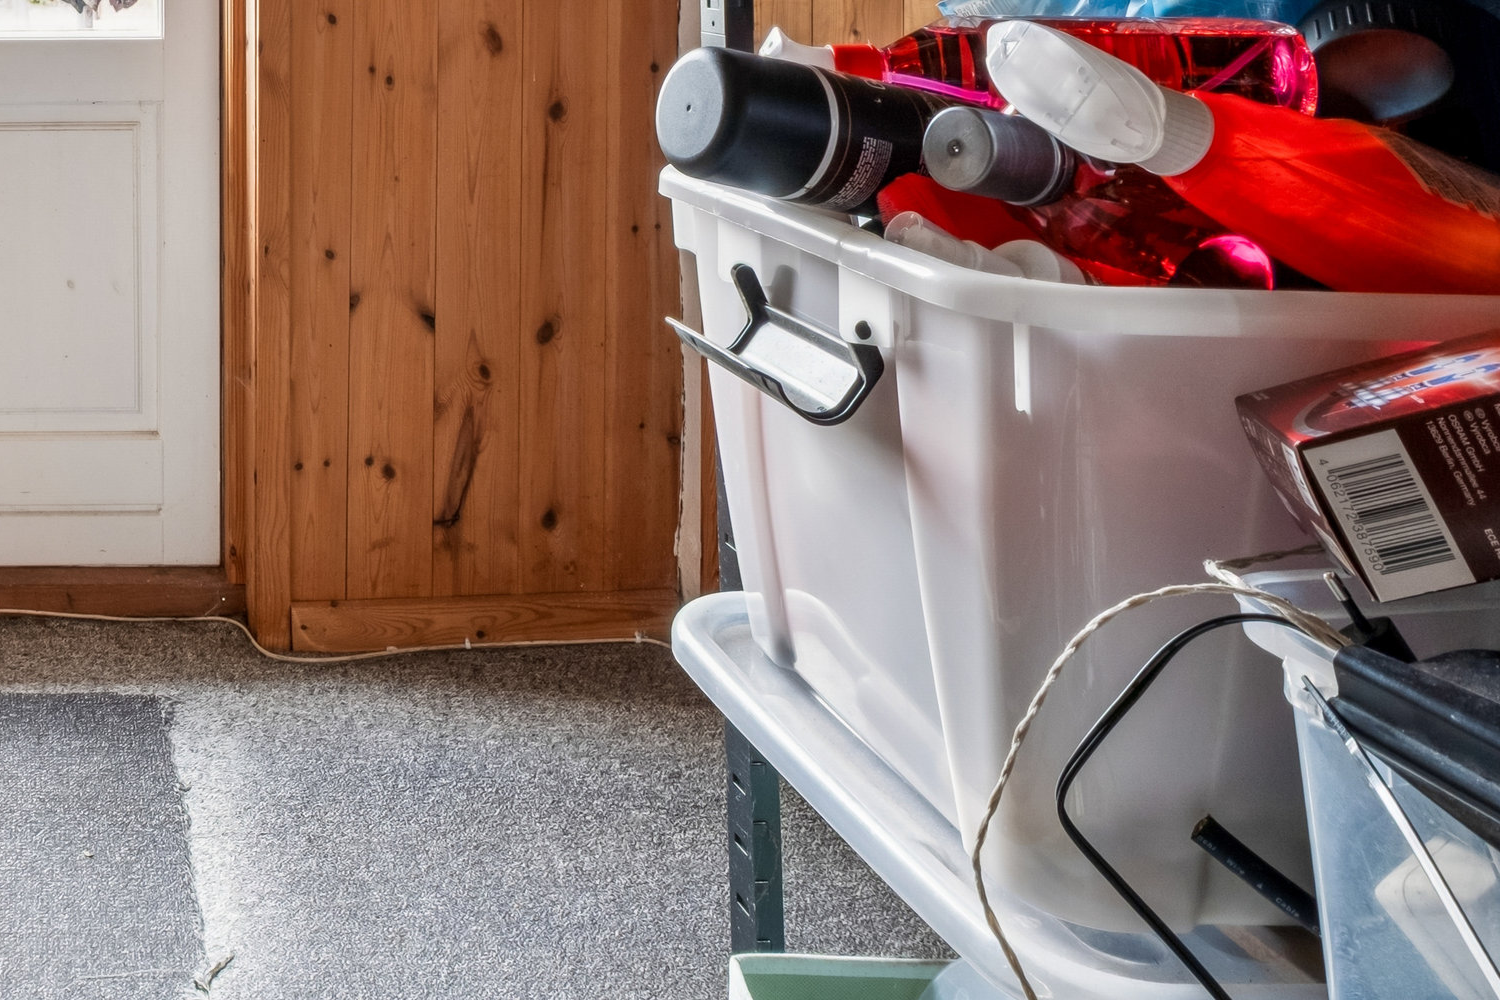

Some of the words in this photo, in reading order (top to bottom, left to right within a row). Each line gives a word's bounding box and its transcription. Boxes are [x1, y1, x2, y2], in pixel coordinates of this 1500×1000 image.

[1425, 420, 1444, 445] 13629
[1453, 471, 1477, 507] Germany
[1447, 414, 1471, 446] OSRAM
[1465, 446, 1486, 473] GmbH
[1319, 458, 1329, 467] 4
[1326, 474, 1358, 521] 062172
[1352, 523, 1385, 572] 387590
[1484, 528, 1499, 548] ECE
[1275, 897, 1300, 918] Cable
